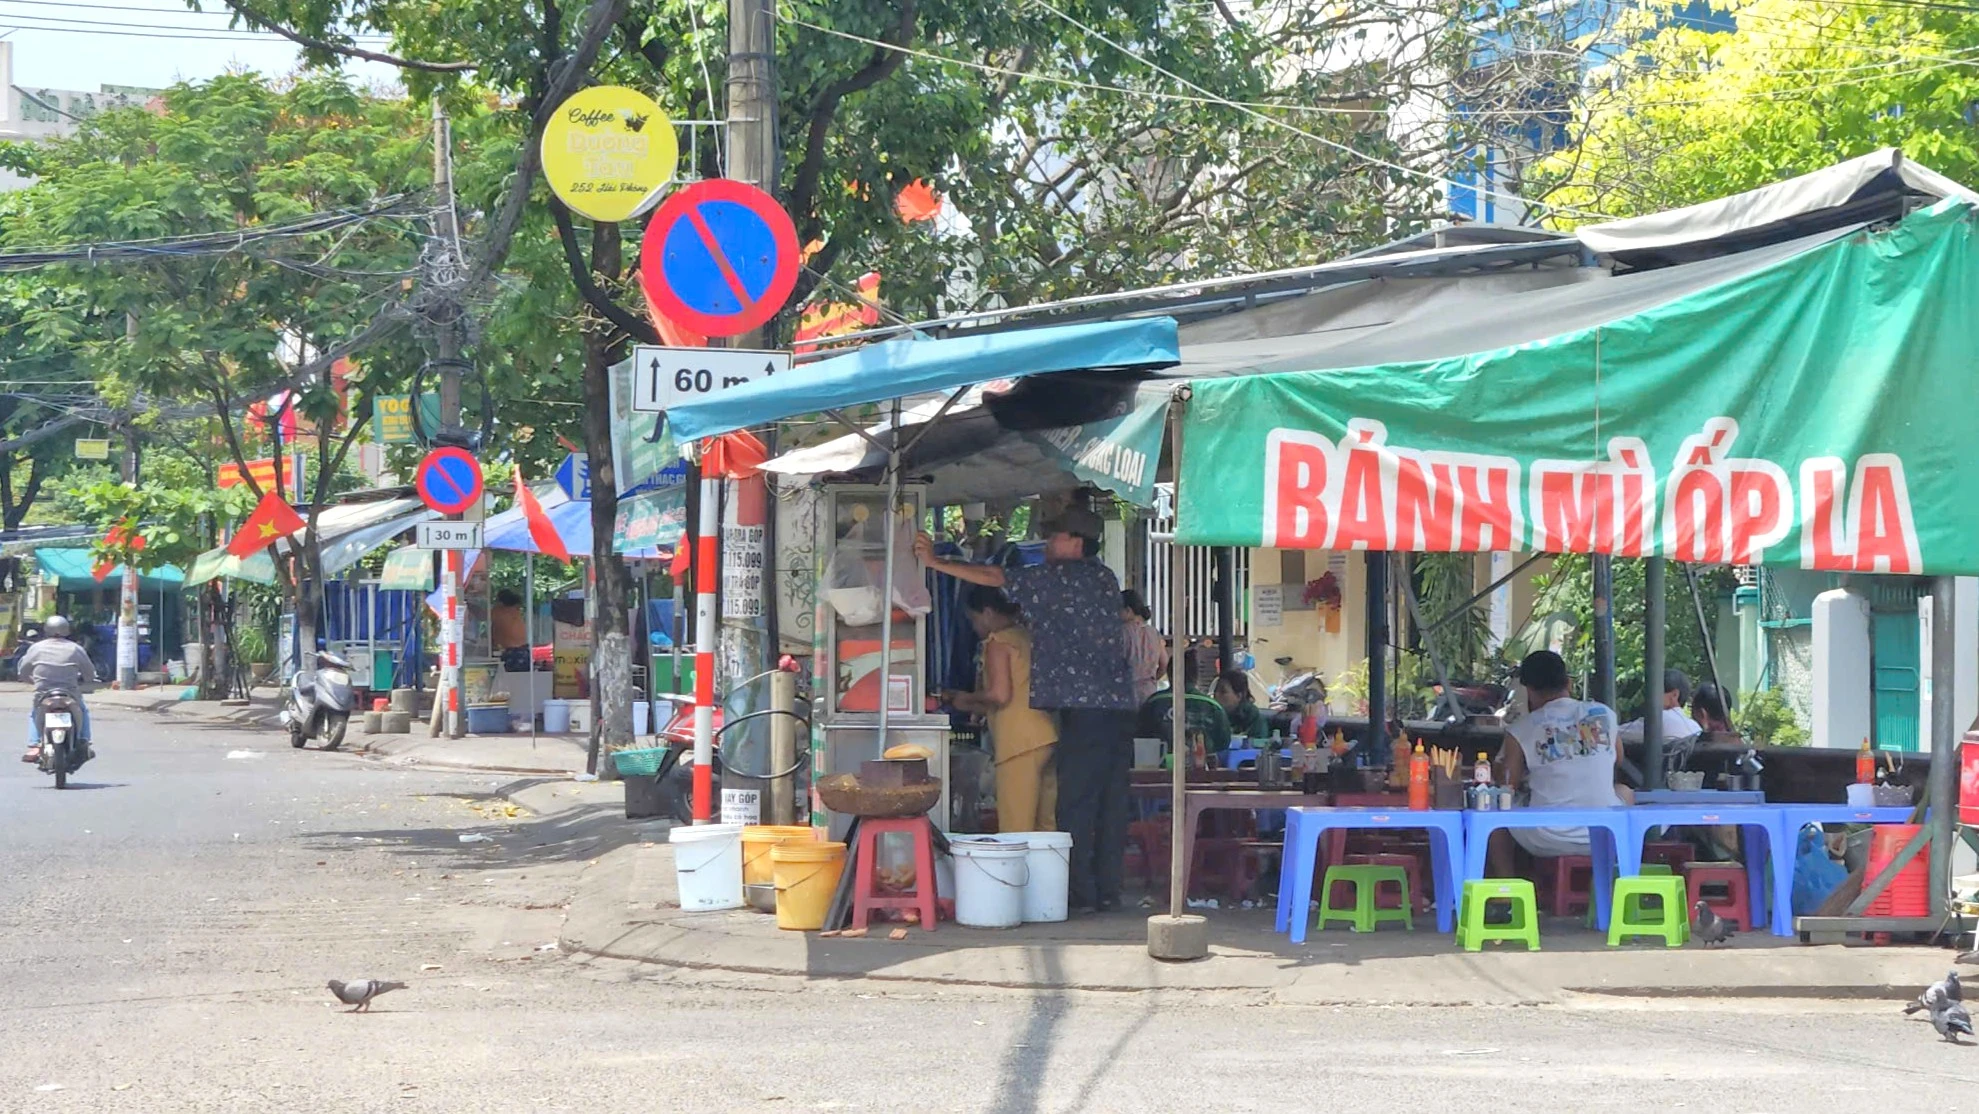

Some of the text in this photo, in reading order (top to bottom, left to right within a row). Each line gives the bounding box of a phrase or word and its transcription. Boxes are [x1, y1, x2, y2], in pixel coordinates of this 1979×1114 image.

[567, 107, 616, 127] Coffee
[570, 182, 594, 193] 252
[675, 368, 713, 393] 60
[1113, 445, 1146, 492] LOẠI
[1270, 424, 1914, 573] BÁNH MÌ ỐP LA
[435, 530, 468, 541] 30 m
